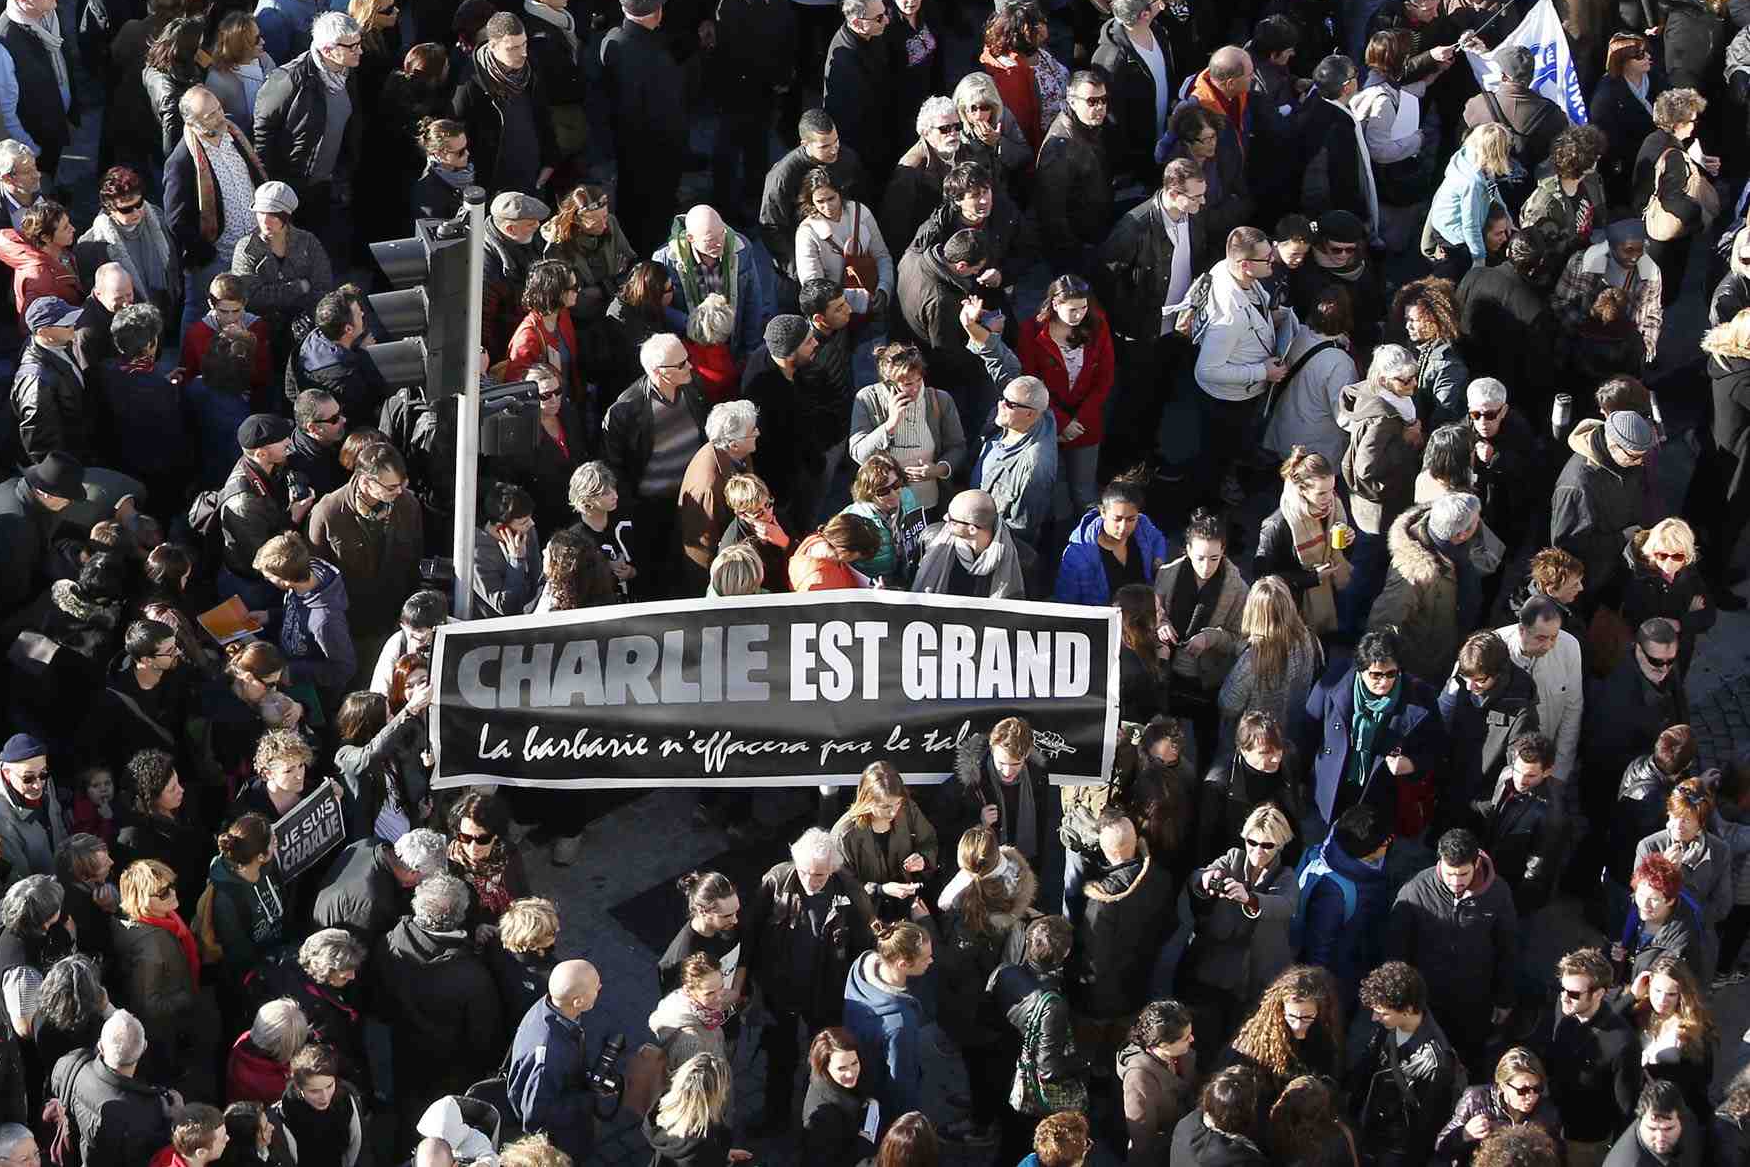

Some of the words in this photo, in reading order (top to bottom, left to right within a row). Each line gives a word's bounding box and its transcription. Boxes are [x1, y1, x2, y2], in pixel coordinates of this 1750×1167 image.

[457, 624, 770, 709] CHARLIE
[790, 621, 888, 702] EST
[901, 621, 1091, 701] GRAND
[478, 723, 512, 760] La
[522, 726, 648, 762] barbarie
[659, 729, 809, 773] n'effacera
[820, 737, 872, 766] pas
[883, 725, 910, 751] le
[281, 825, 300, 851] JE
[302, 796, 335, 836] SUIS
[282, 814, 339, 871] CHARLIE
